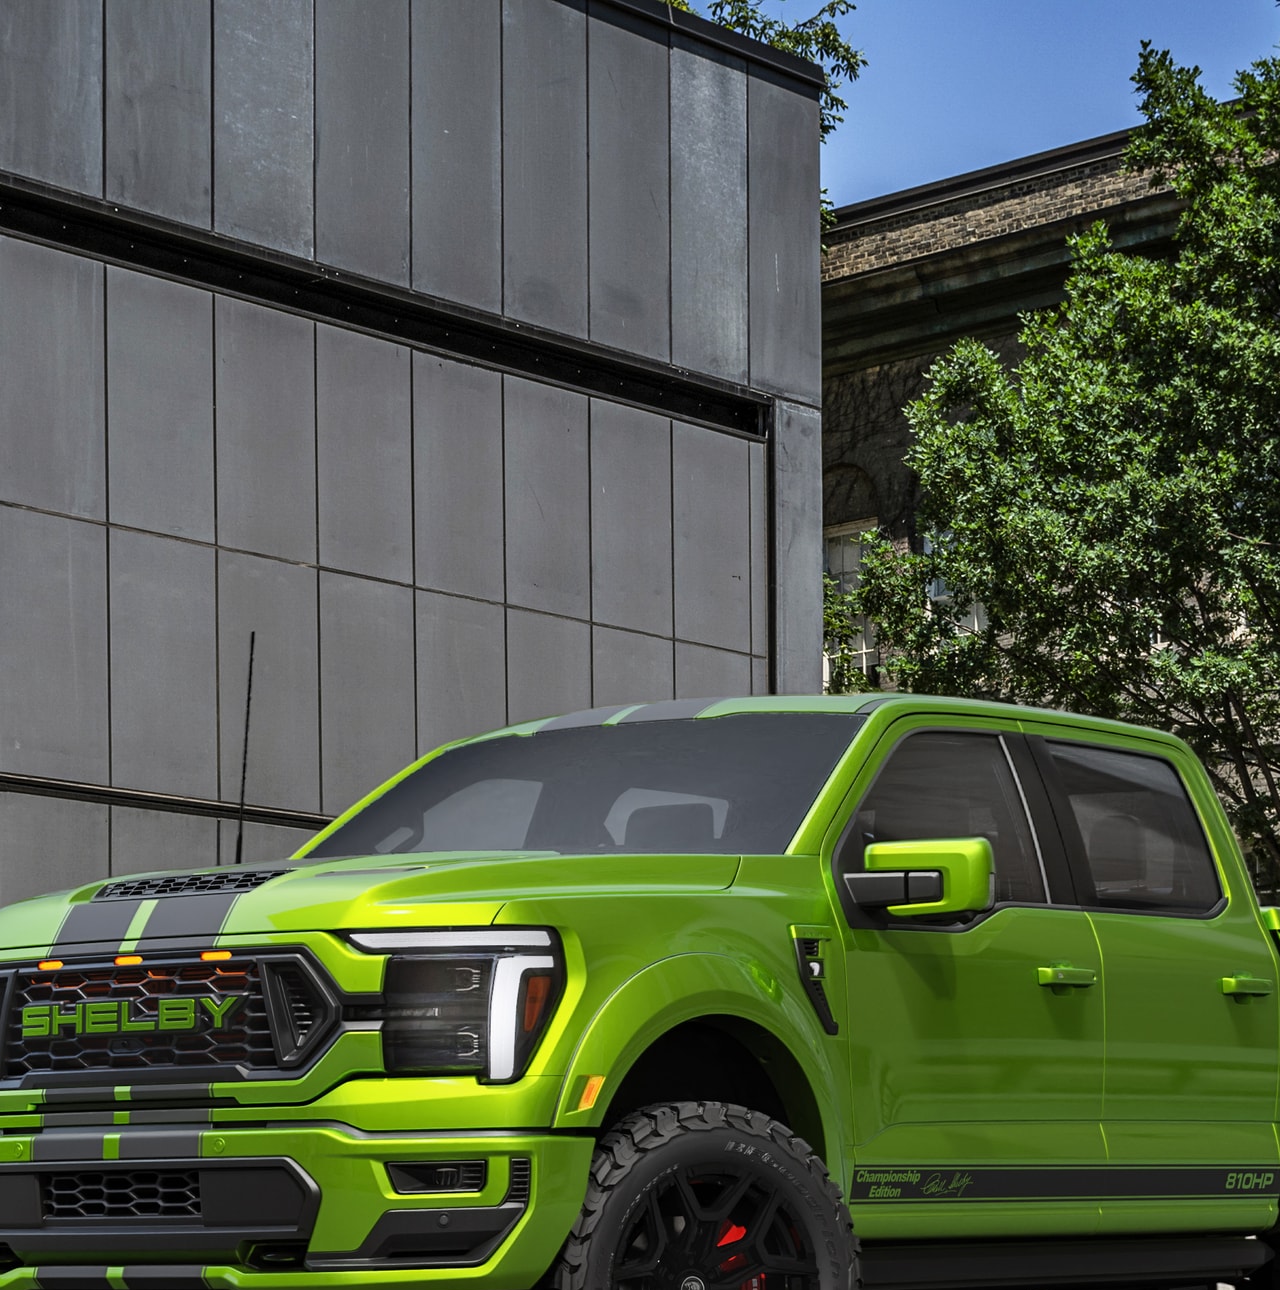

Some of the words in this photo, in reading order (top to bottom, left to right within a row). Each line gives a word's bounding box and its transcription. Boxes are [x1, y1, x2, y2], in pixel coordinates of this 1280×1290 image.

[22, 996, 239, 1037] SHELBY
[856, 1170, 921, 1184] Championship
[1225, 1172, 1274, 1189] 810HP
[869, 1185, 901, 1197] Edition
